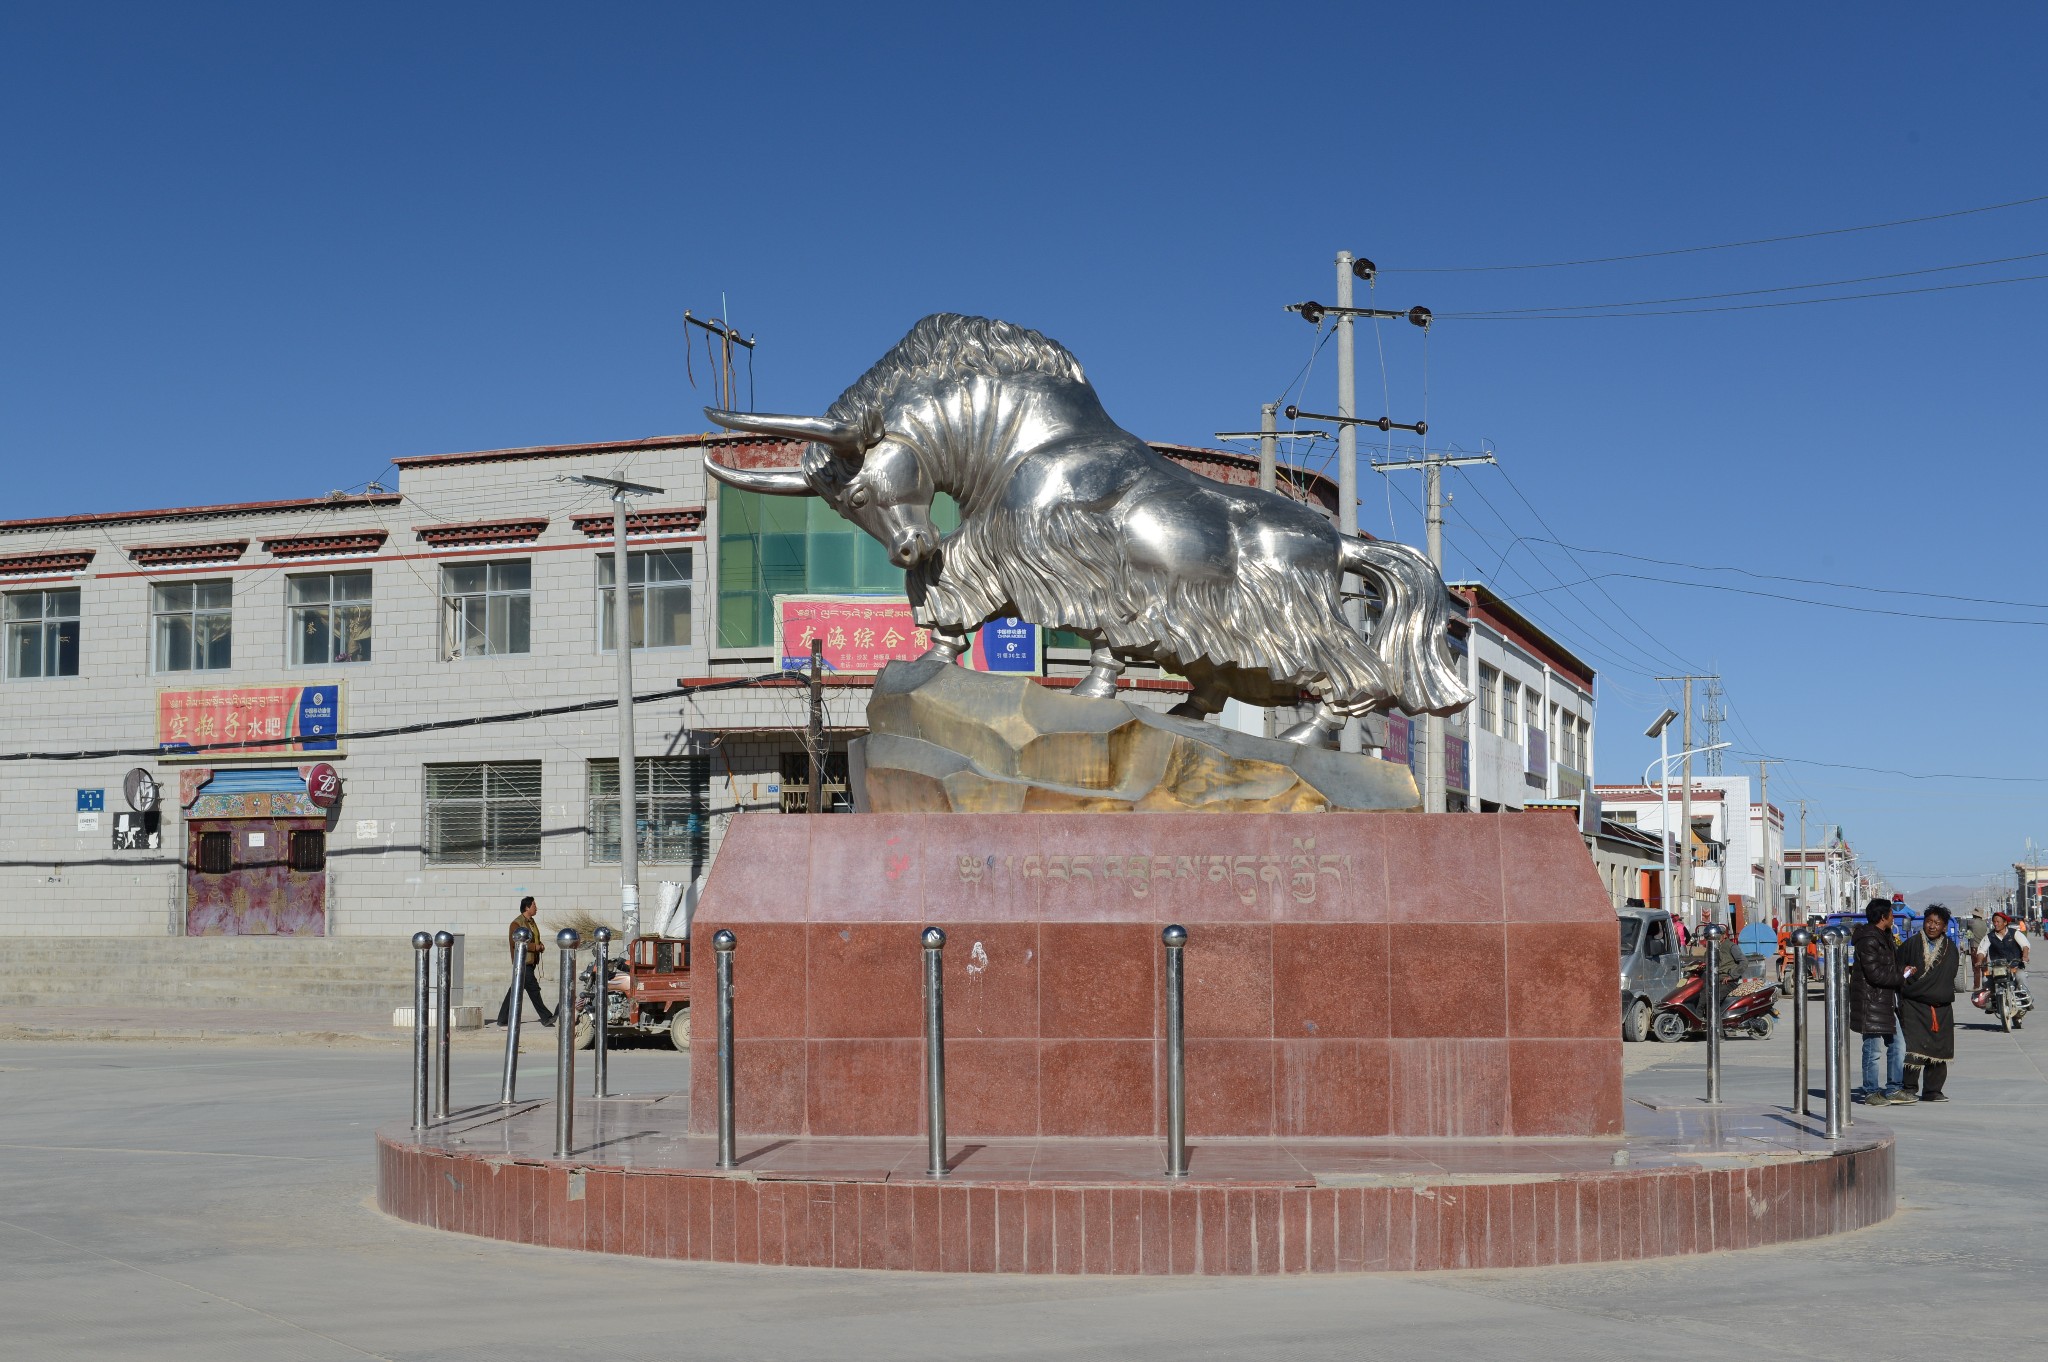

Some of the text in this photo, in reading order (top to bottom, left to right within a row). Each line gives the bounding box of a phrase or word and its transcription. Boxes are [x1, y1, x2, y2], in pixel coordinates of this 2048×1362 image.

[798, 625, 932, 651] 龙海综合商
[169, 711, 281, 740] 空瓶子水吧
